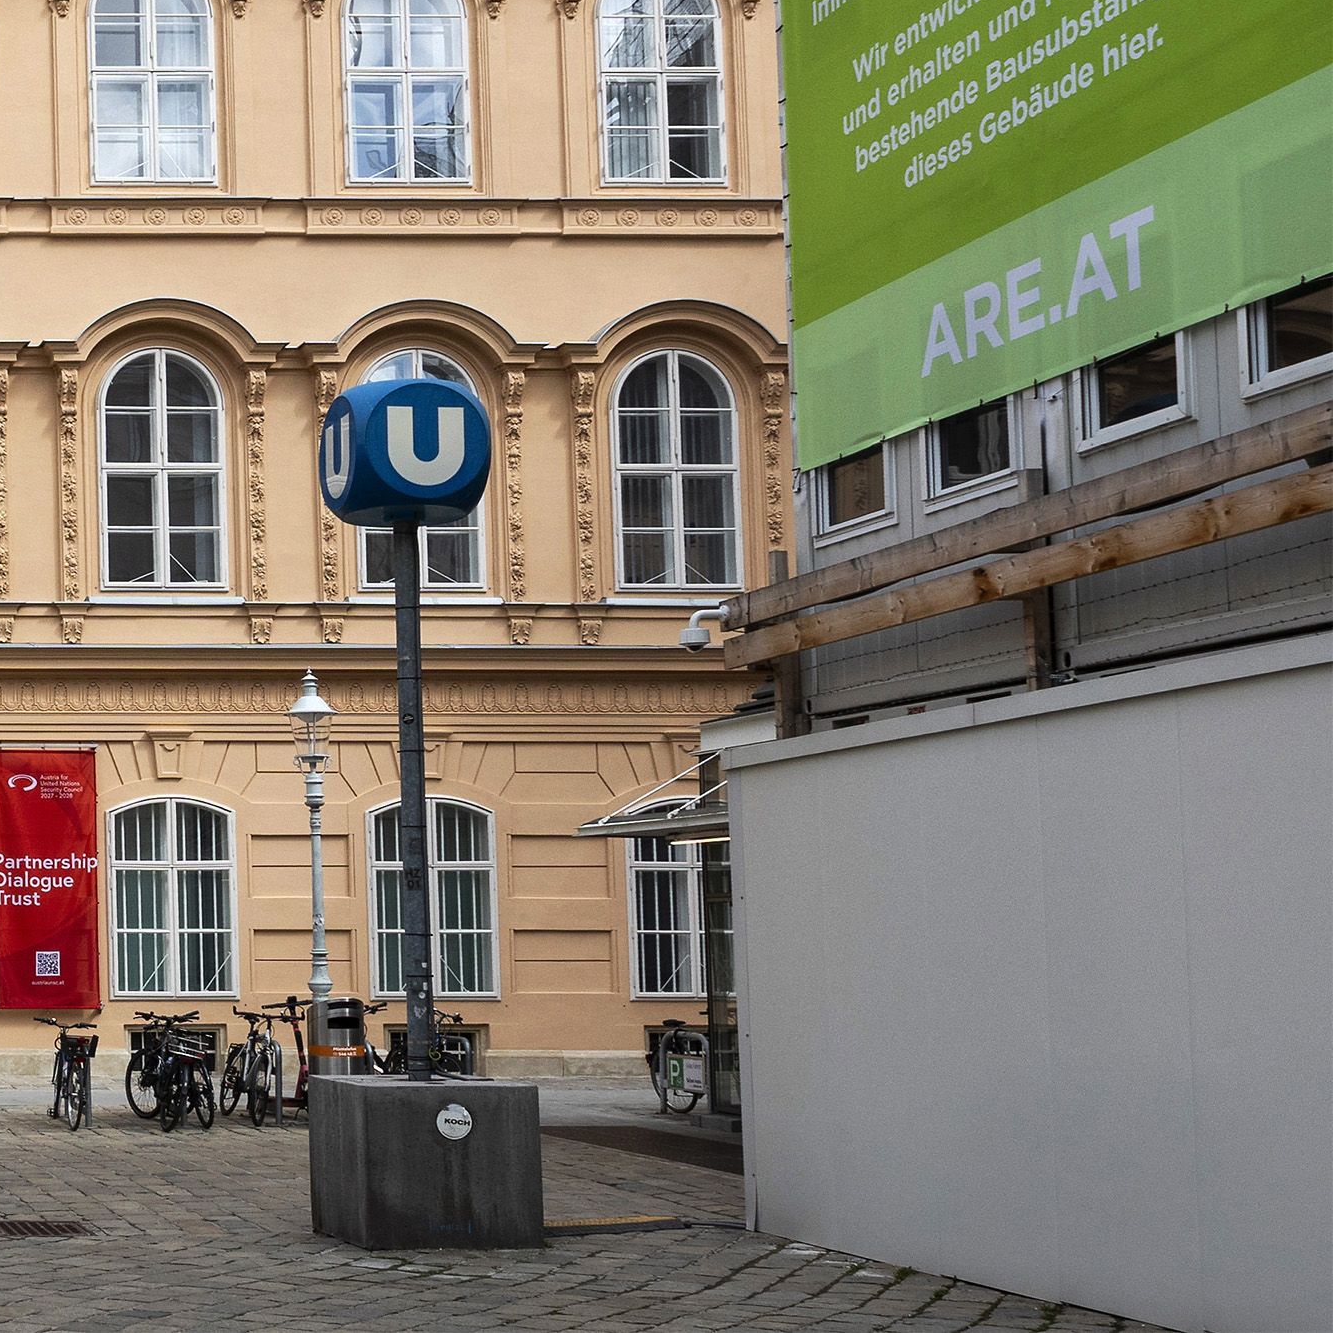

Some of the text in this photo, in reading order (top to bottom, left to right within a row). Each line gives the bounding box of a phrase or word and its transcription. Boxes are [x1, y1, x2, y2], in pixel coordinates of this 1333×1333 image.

[843, 90, 880, 134] und
[888, 31, 980, 105] erhalten
[852, 41, 889, 84] Wir
[905, 25, 1163, 186] dieses Gebäude hier.
[856, 81, 979, 170] bestehende
[920, 204, 1157, 379] ARE.AT
[325, 412, 350, 499] U
[386, 406, 465, 486] U
[670, 1060, 680, 1085] P
[444, 1118, 470, 1126] KOCH
